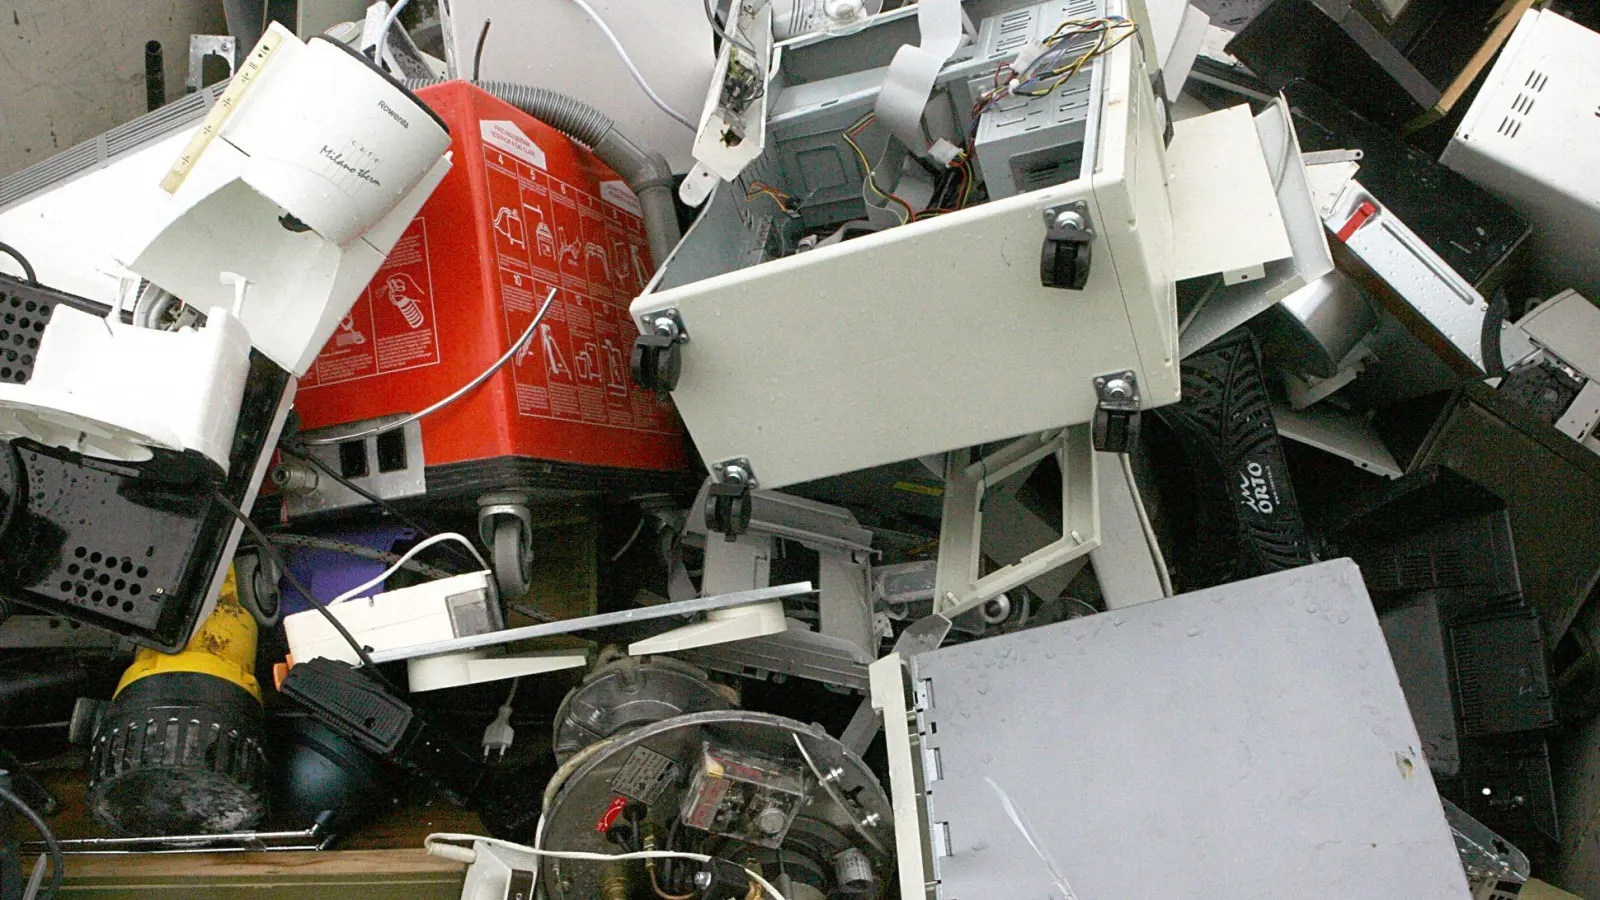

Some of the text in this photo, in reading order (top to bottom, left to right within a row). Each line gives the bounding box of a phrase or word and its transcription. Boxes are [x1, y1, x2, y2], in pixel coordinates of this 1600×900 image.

[378, 100, 409, 129] Rowenta
[319, 145, 381, 186] Milano therm
[498, 154, 504, 165] 4
[530, 168, 536, 180] 5
[514, 274, 522, 286] 10
[1238, 470, 1260, 513] in
[1247, 462, 1274, 514] ORTO
